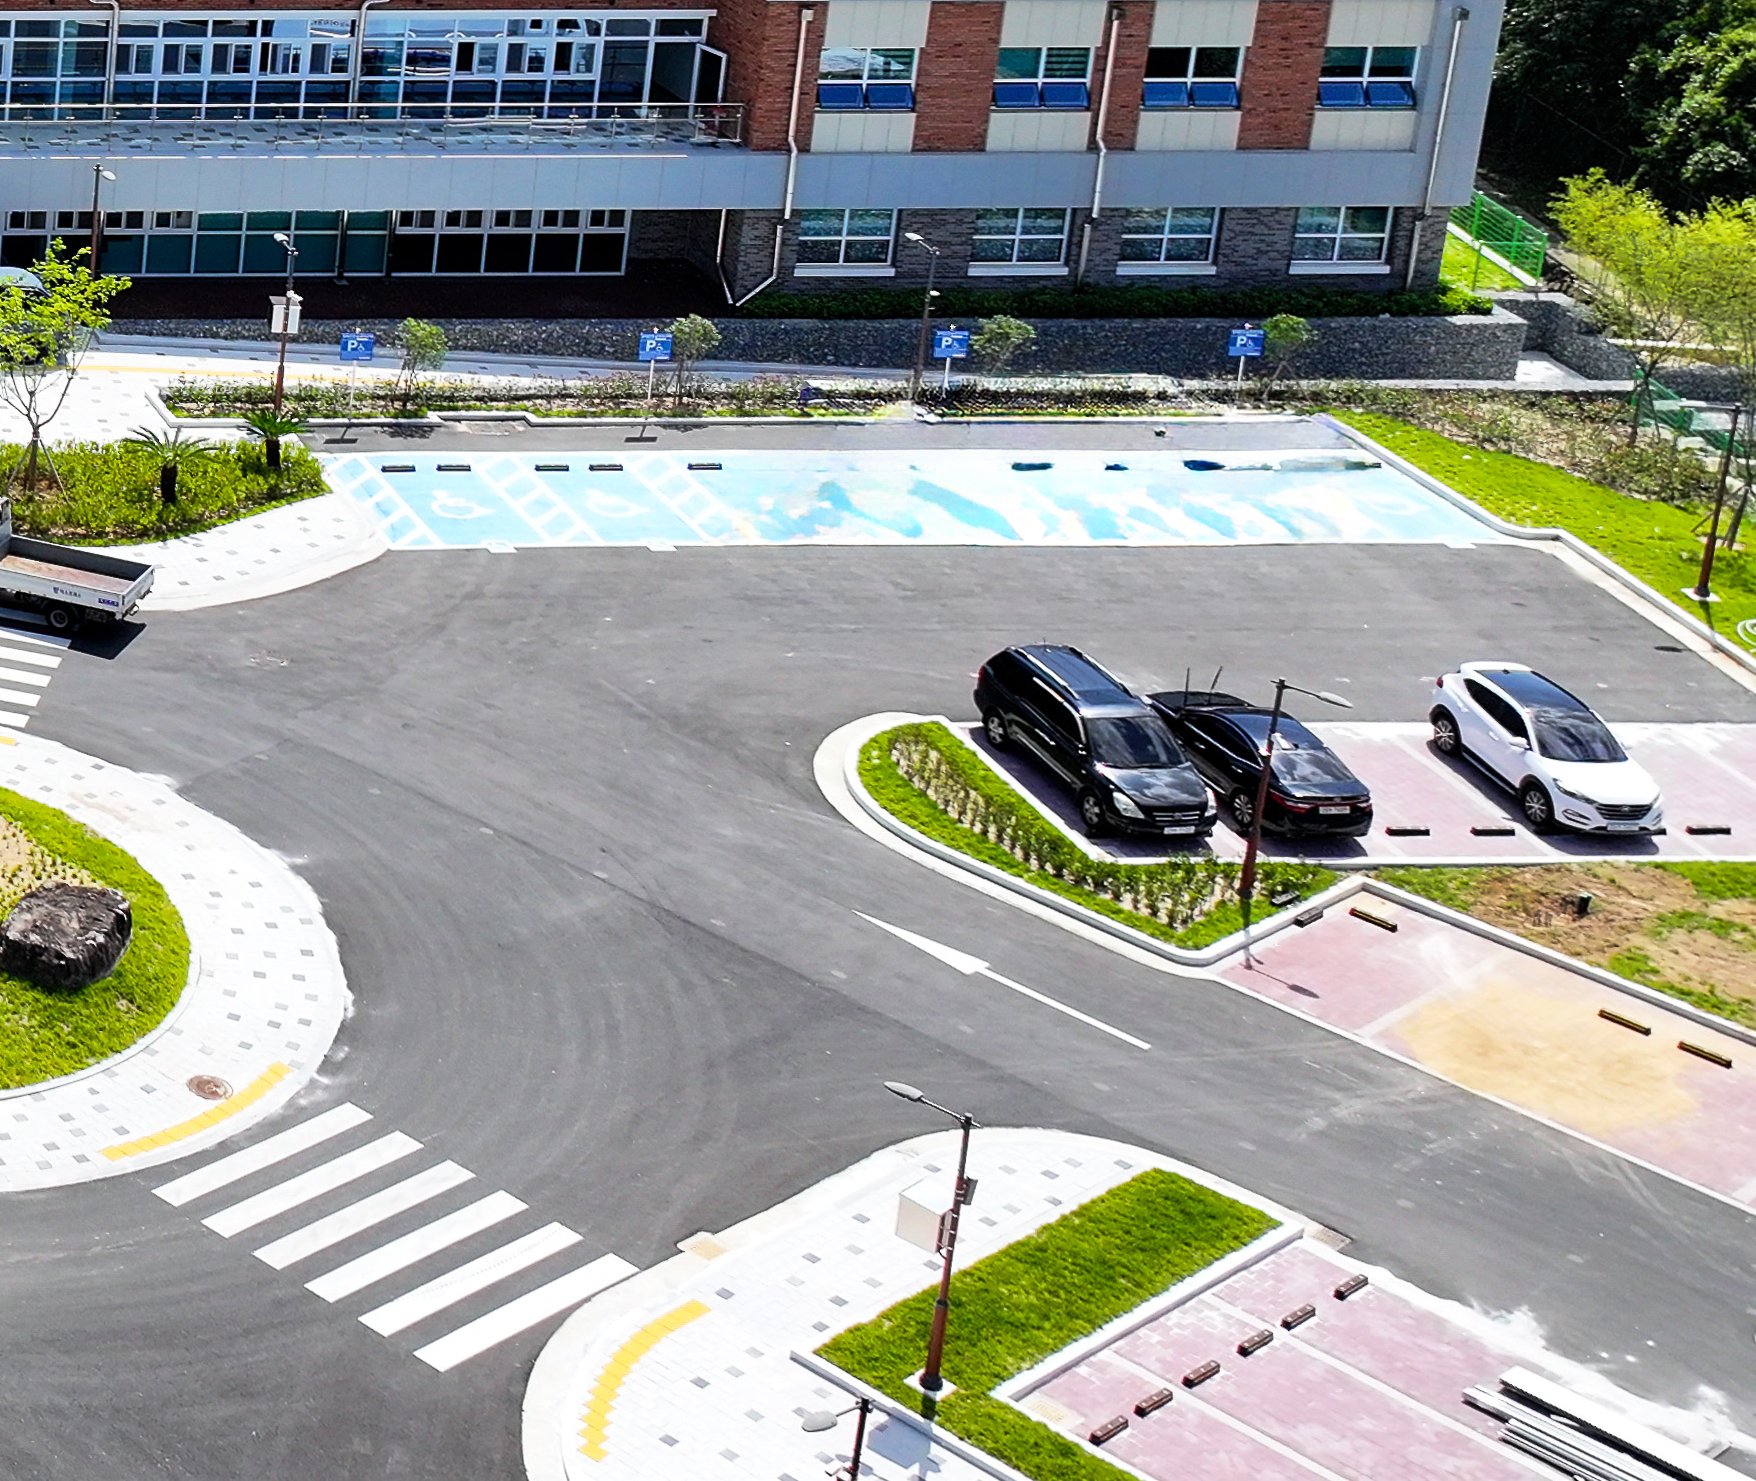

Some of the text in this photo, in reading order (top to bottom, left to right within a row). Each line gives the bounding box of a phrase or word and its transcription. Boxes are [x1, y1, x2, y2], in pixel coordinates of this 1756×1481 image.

[347, 340, 358, 352] P
[645, 339, 656, 352] P
[941, 336, 953, 349] P
[1236, 335, 1247, 348] P
